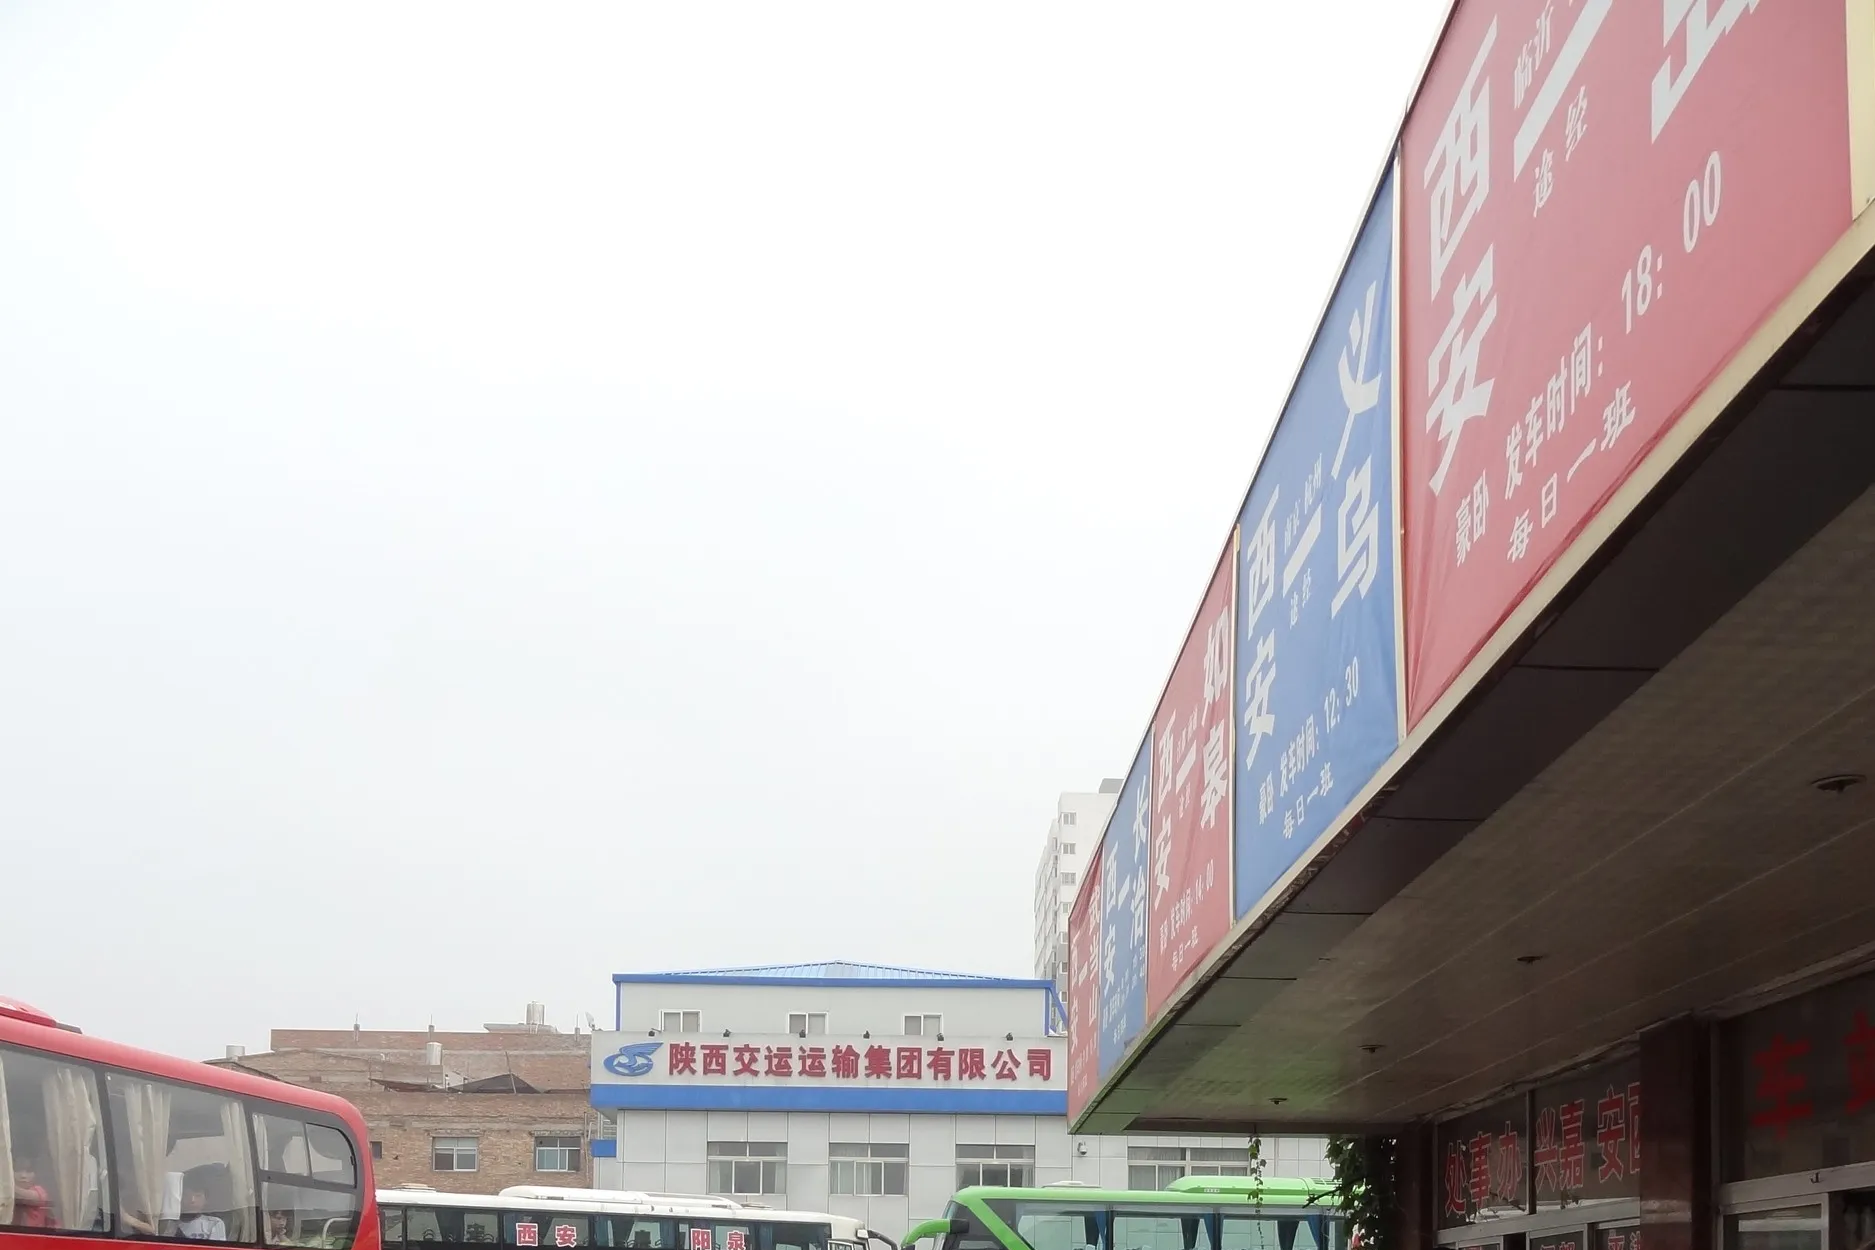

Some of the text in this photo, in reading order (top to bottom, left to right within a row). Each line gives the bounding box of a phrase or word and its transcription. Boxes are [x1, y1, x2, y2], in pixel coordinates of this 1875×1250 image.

[1533, 85, 1588, 218] 途经
[1423, 13, 1498, 496] 西安
[1330, 280, 1382, 619] 义乌
[1507, 380, 1636, 562] 每日一班
[1201, 605, 1230, 829] 如皋
[1244, 483, 1281, 770] 西安
[1130, 774, 1148, 951] 长治
[1155, 708, 1177, 912] 西安
[1104, 839, 1119, 998] 西安
[667, 1041, 1053, 1081] 陕西交运运输集团有限公司
[515, 1222, 578, 1249] 西安
